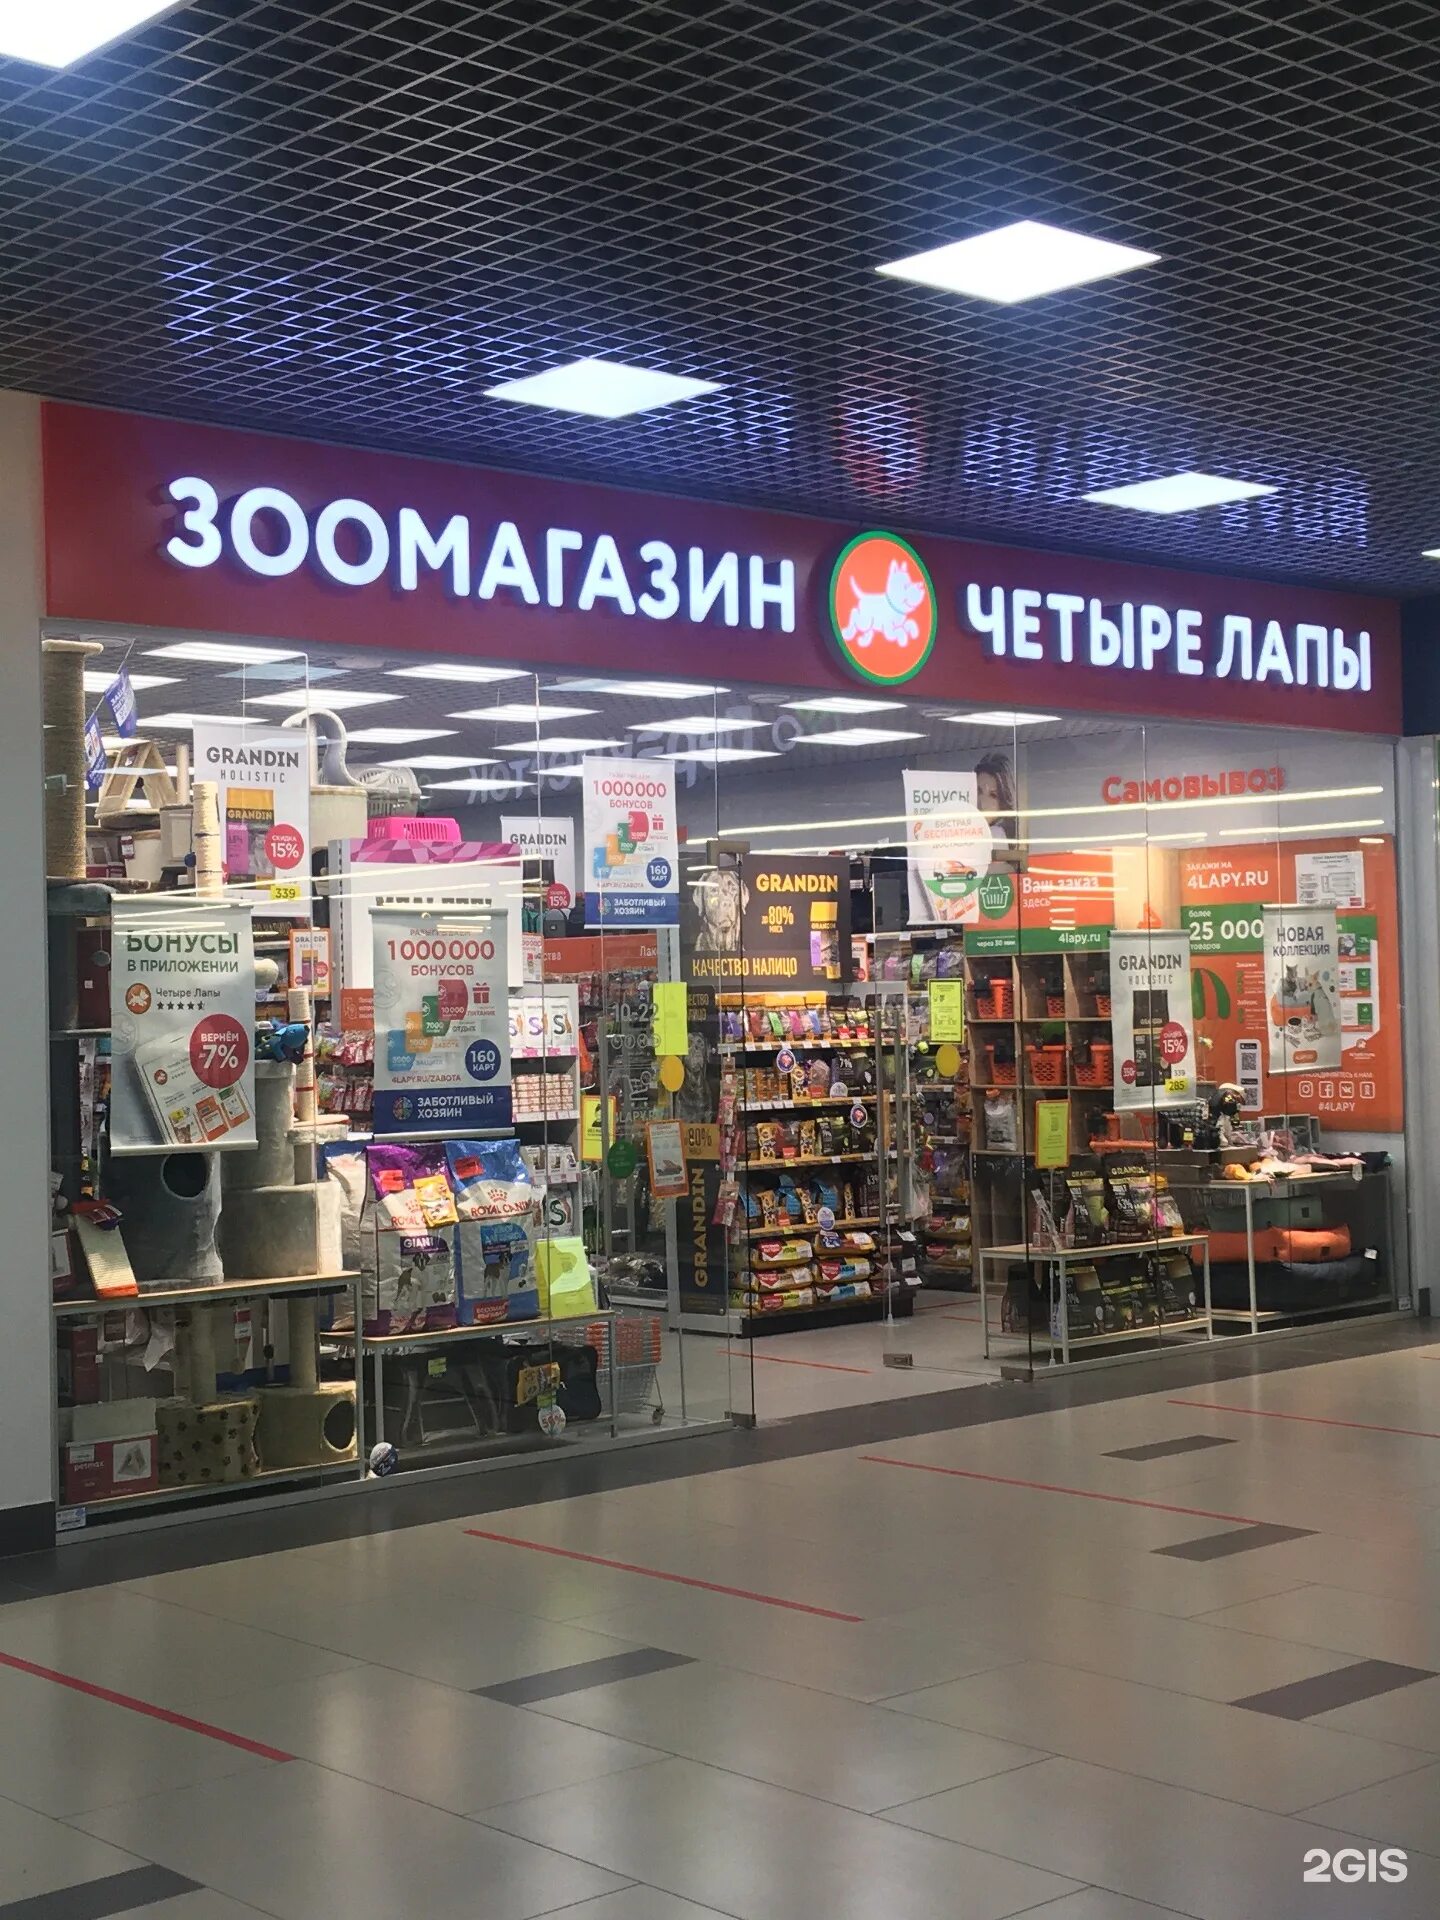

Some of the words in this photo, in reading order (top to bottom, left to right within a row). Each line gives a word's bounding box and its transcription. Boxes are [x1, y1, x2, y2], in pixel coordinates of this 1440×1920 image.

[167, 476, 795, 632] ЗООМАГАЗИН
[966, 583, 1203, 675] ЧЕТЫРЕ
[1216, 614, 1371, 691] ЛАПЫ
[206, 747, 299, 768] GRANDIN
[220, 769, 285, 783] HOLISTIC
[1101, 766, 1286, 804] Самовывоз
[913, 790, 969, 803] БОНУСЫ
[609, 800, 653, 809] БОНУСОВ
[228, 810, 272, 820] GRANDIN
[271, 843, 299, 858] 15%
[650, 865, 668, 875] 160
[1186, 863, 1219, 872] ЗАКАЖИ
[1221, 861, 1233, 869] НА
[756, 874, 838, 892] GRANDIN
[1022, 877, 1053, 894] Ваш
[1187, 870, 1269, 889] 4LAPY.RU
[275, 888, 296, 898] 339
[549, 896, 568, 907] 15%
[613, 898, 666, 908] ЗАБОТЛИВЫЙ
[1023, 898, 1052, 908] здесь
[614, 906, 645, 916] ХОЗЯИН
[769, 906, 794, 925] 80%
[1188, 910, 1212, 918] более
[1188, 922, 1213, 940] 25
[1220, 920, 1264, 939] 000
[1277, 926, 1324, 943] НОВАЯ
[127, 930, 239, 954] БОНУСЫ
[1058, 933, 1101, 945] 4lapy.ru
[1273, 943, 1330, 957] КОЛЛЕКЦИЯ
[127, 960, 136, 972] В
[140, 960, 239, 972] ПРИЛОЖЕНИИ
[692, 958, 749, 976] КАЧЕСТВО
[753, 957, 797, 978] НАЛИЦО
[1119, 954, 1182, 971] GRANDIN
[411, 964, 474, 976] БОНУСОВ
[156, 988, 191, 998] Четыре
[194, 988, 221, 998] Лапы
[201, 1031, 239, 1042] ВЕРНЁМ
[1163, 1039, 1185, 1054] 15%
[471, 1050, 496, 1063] 160
[472, 1063, 496, 1072] КАРТ
[1169, 1080, 1185, 1091] 285
[417, 1093, 494, 1107] ЗАБОТЛИВЫЙ
[417, 1108, 462, 1119] ХОЗЯИН
[1318, 1102, 1356, 1112] #4LAPY
[471, 1205, 501, 1217] ROYAL
[692, 1168, 708, 1287] GRANDIN
